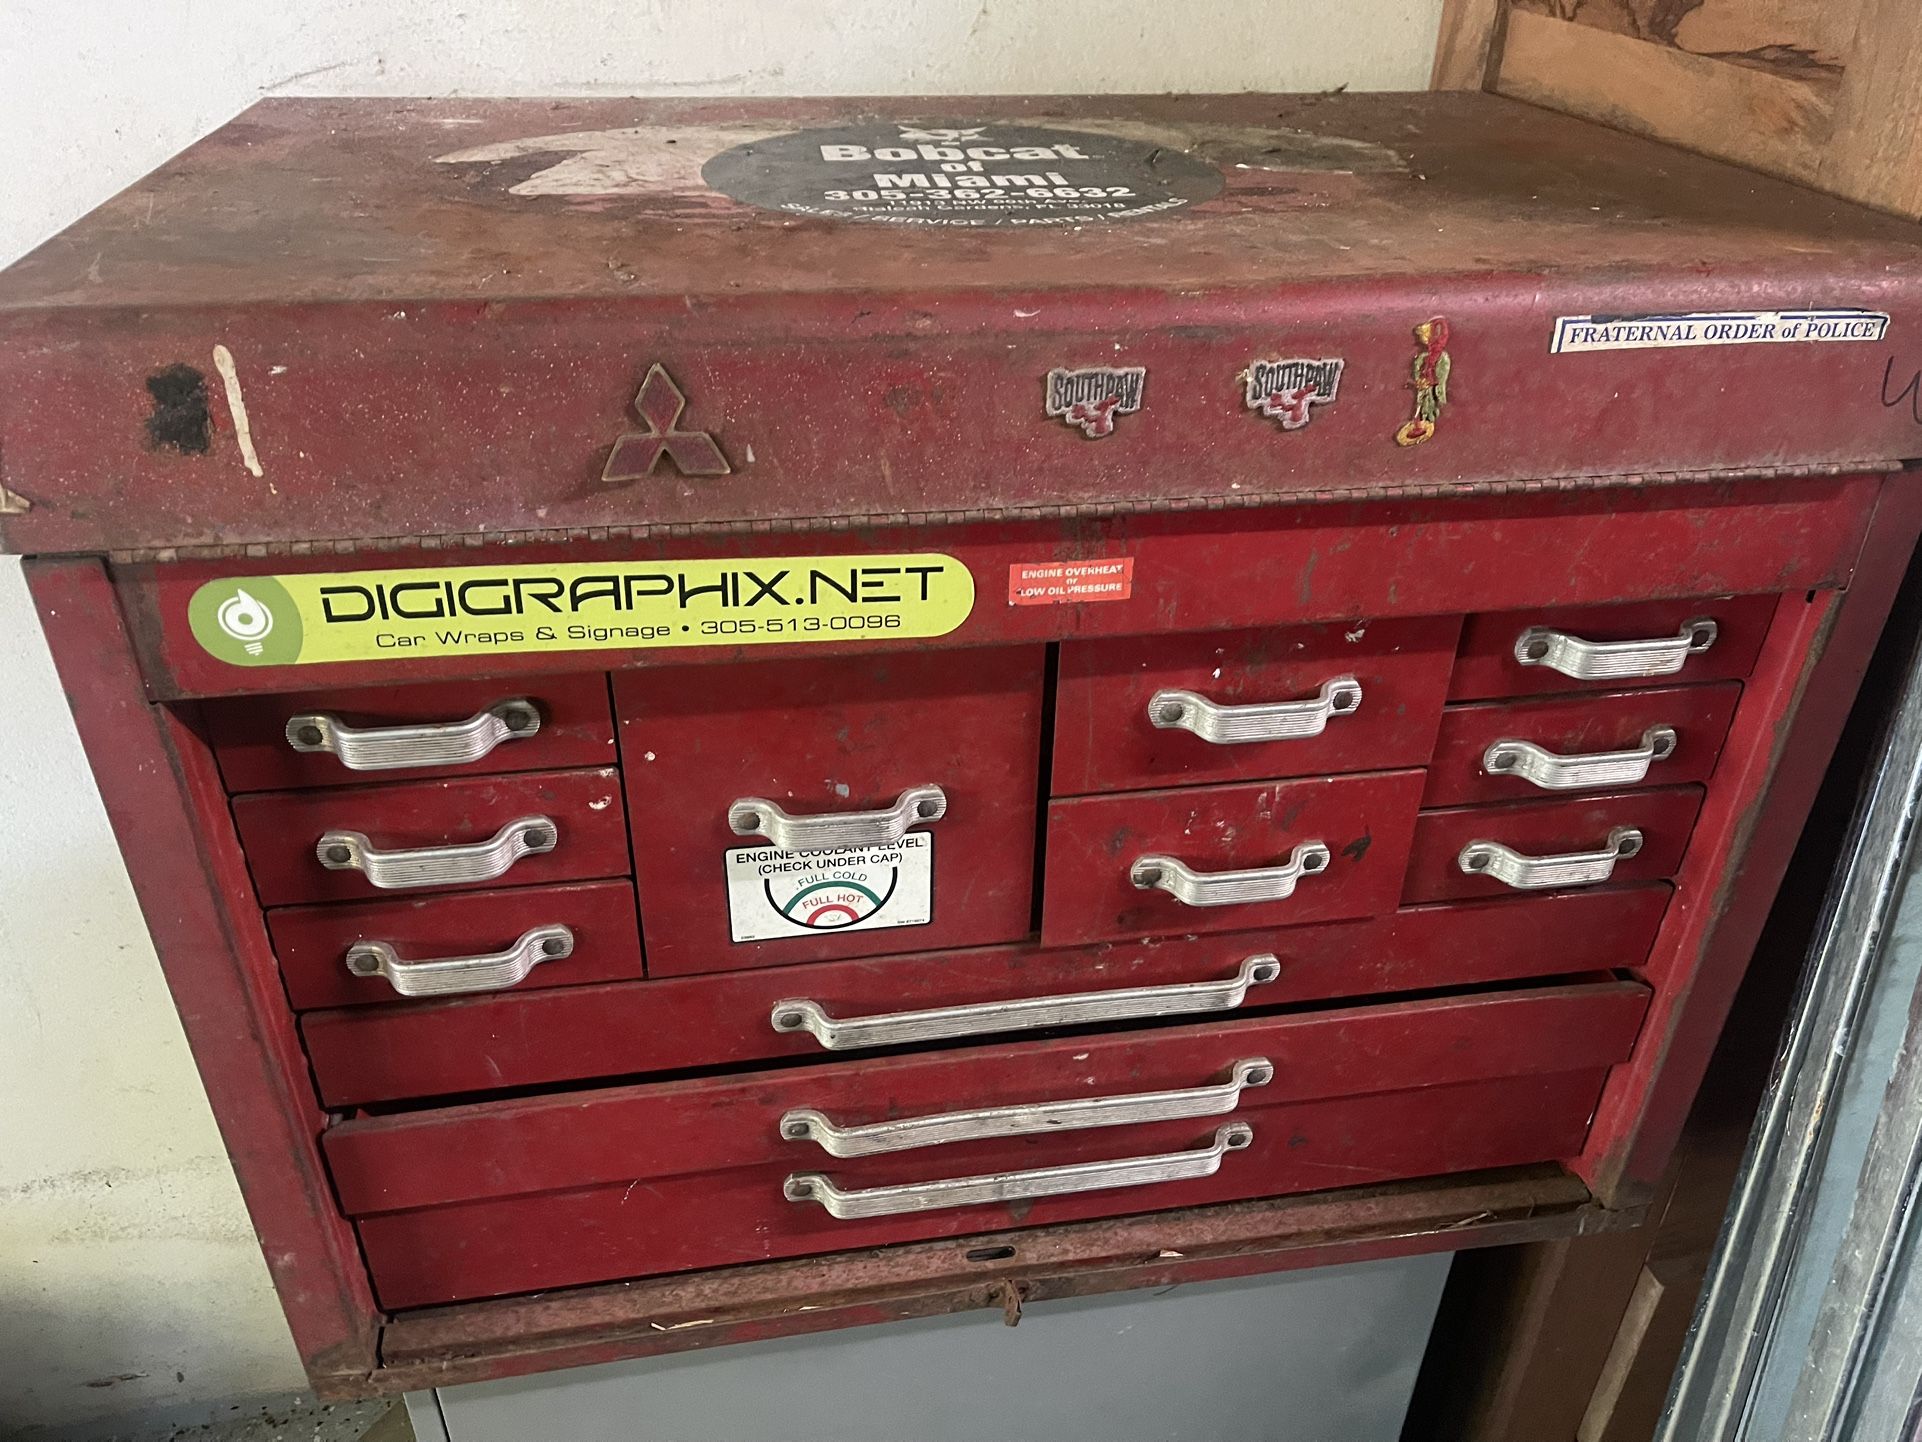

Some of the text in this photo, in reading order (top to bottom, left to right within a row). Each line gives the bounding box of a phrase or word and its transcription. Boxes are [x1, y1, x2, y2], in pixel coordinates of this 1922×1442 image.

[820, 144, 1089, 161] Bobcat
[940, 161, 984, 172] of
[873, 172, 1069, 187] Miami
[824, 187, 1136, 200] 305-362-6632
[1570, 320, 1876, 344] FRATERNAL ORDER of POLICE
[1251, 362, 1340, 400] SOUTHPAW
[1052, 374, 1142, 411] SOUTHPAW
[1021, 564, 1123, 580] ENGINE OVERHEAT
[320, 565, 944, 623] DIGIGRAPHIX.NET
[1020, 582, 1122, 597] LOW OIL PRESSURE
[376, 632, 425, 648] Car
[435, 627, 524, 645] Wraps
[536, 627, 558, 640] &
[568, 618, 671, 640] Signage
[701, 614, 901, 635] 305-513-0096
[736, 851, 795, 864] ENGINE
[877, 838, 924, 851] LEVEL
[758, 851, 903, 877] (CHECK UNDER CAP)
[798, 870, 868, 888] FULL COLD
[802, 893, 864, 909] FULL HOT
